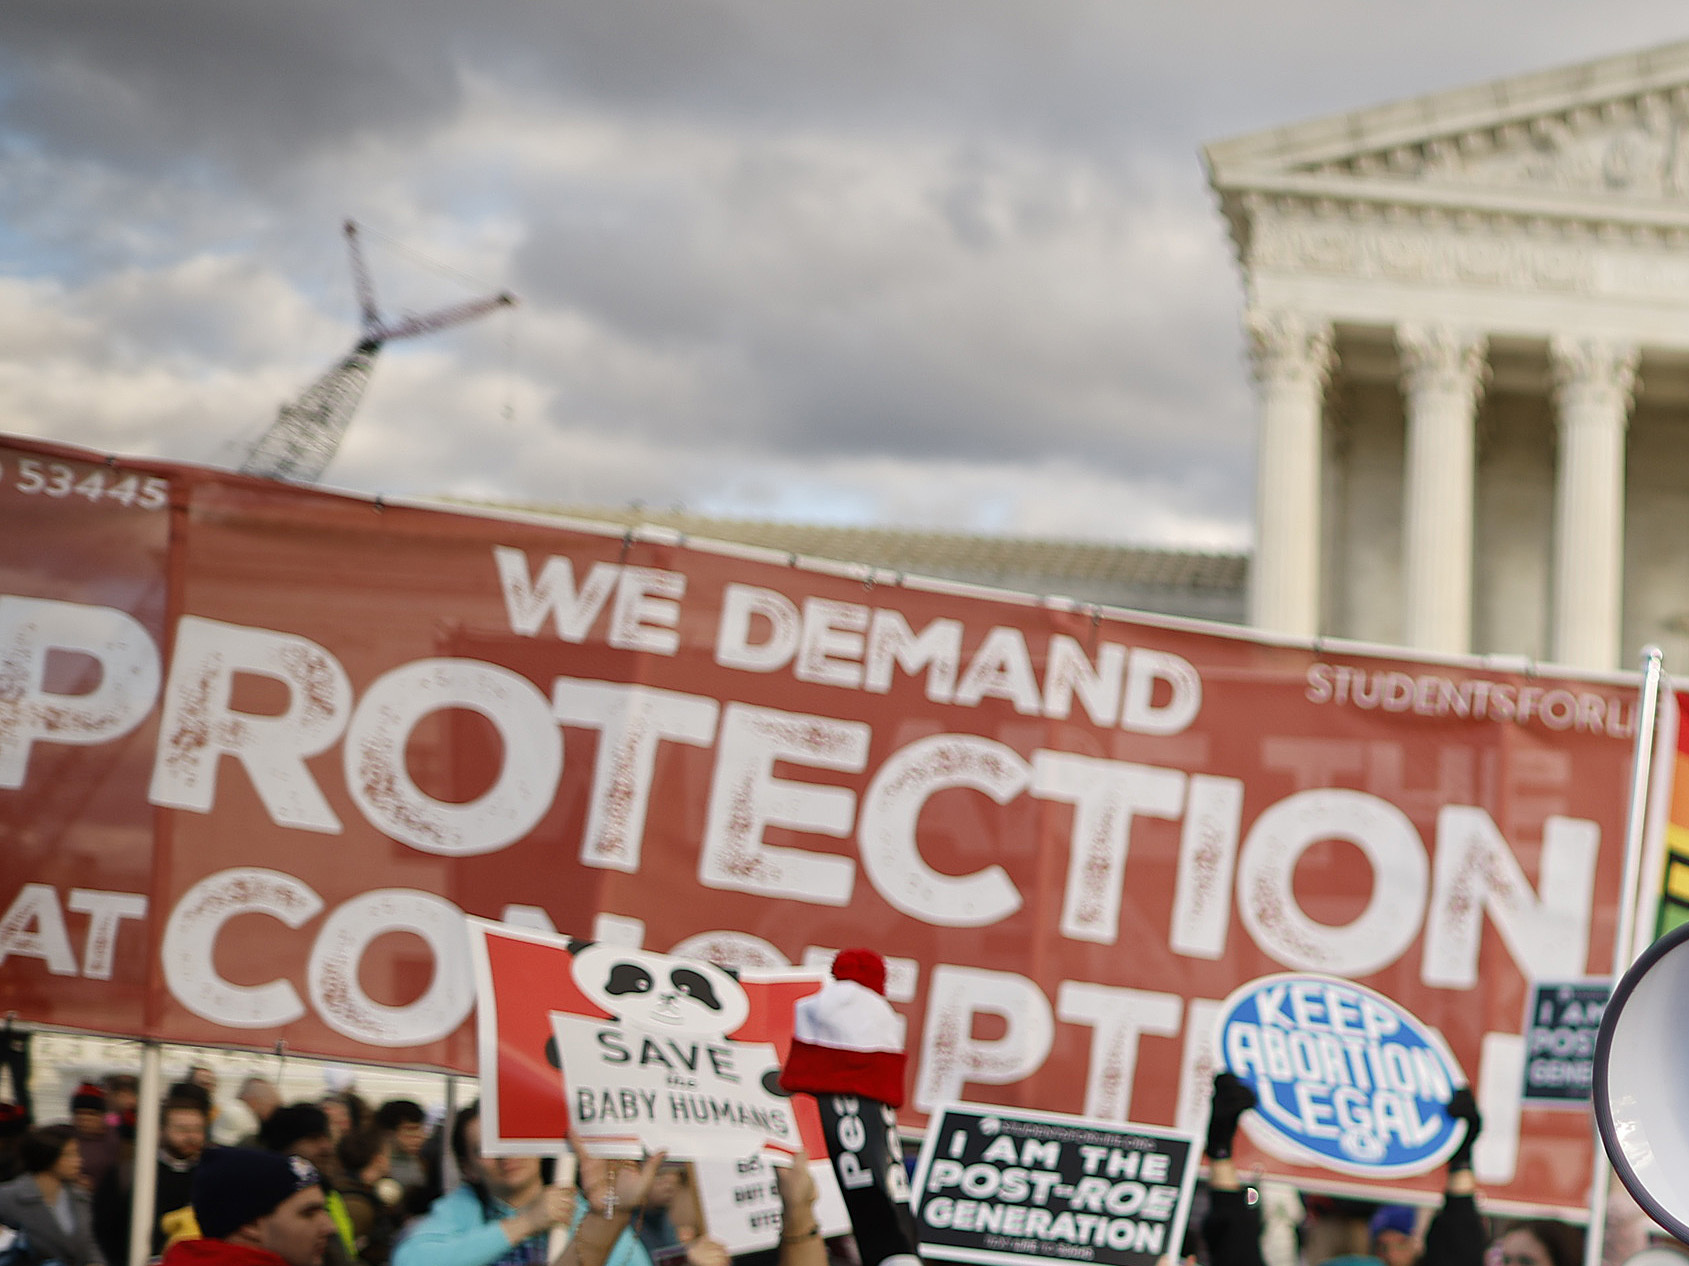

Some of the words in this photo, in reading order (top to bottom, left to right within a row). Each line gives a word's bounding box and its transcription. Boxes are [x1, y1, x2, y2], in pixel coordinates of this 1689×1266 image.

[15, 457, 169, 510] 53445
[493, 545, 687, 656] WE
[716, 582, 1202, 736] DEMAND
[0, 595, 1600, 990] PROTECTION
[0, 883, 147, 981] AT
[1257, 985, 1399, 1040] KEEP
[598, 1028, 741, 1082] SAVE
[1226, 1020, 1451, 1103] ABORTION
[578, 1087, 656, 1124] BABY
[669, 1091, 789, 1137] HUMANS
[1257, 1076, 1443, 1147] LEGAL
[949, 1130, 968, 1158] I
[983, 1135, 1061, 1169] AM
[1080, 1144, 1171, 1183] THE
[927, 1158, 1180, 1221] POST-ROE
[923, 1196, 1165, 1254] GENERATION
